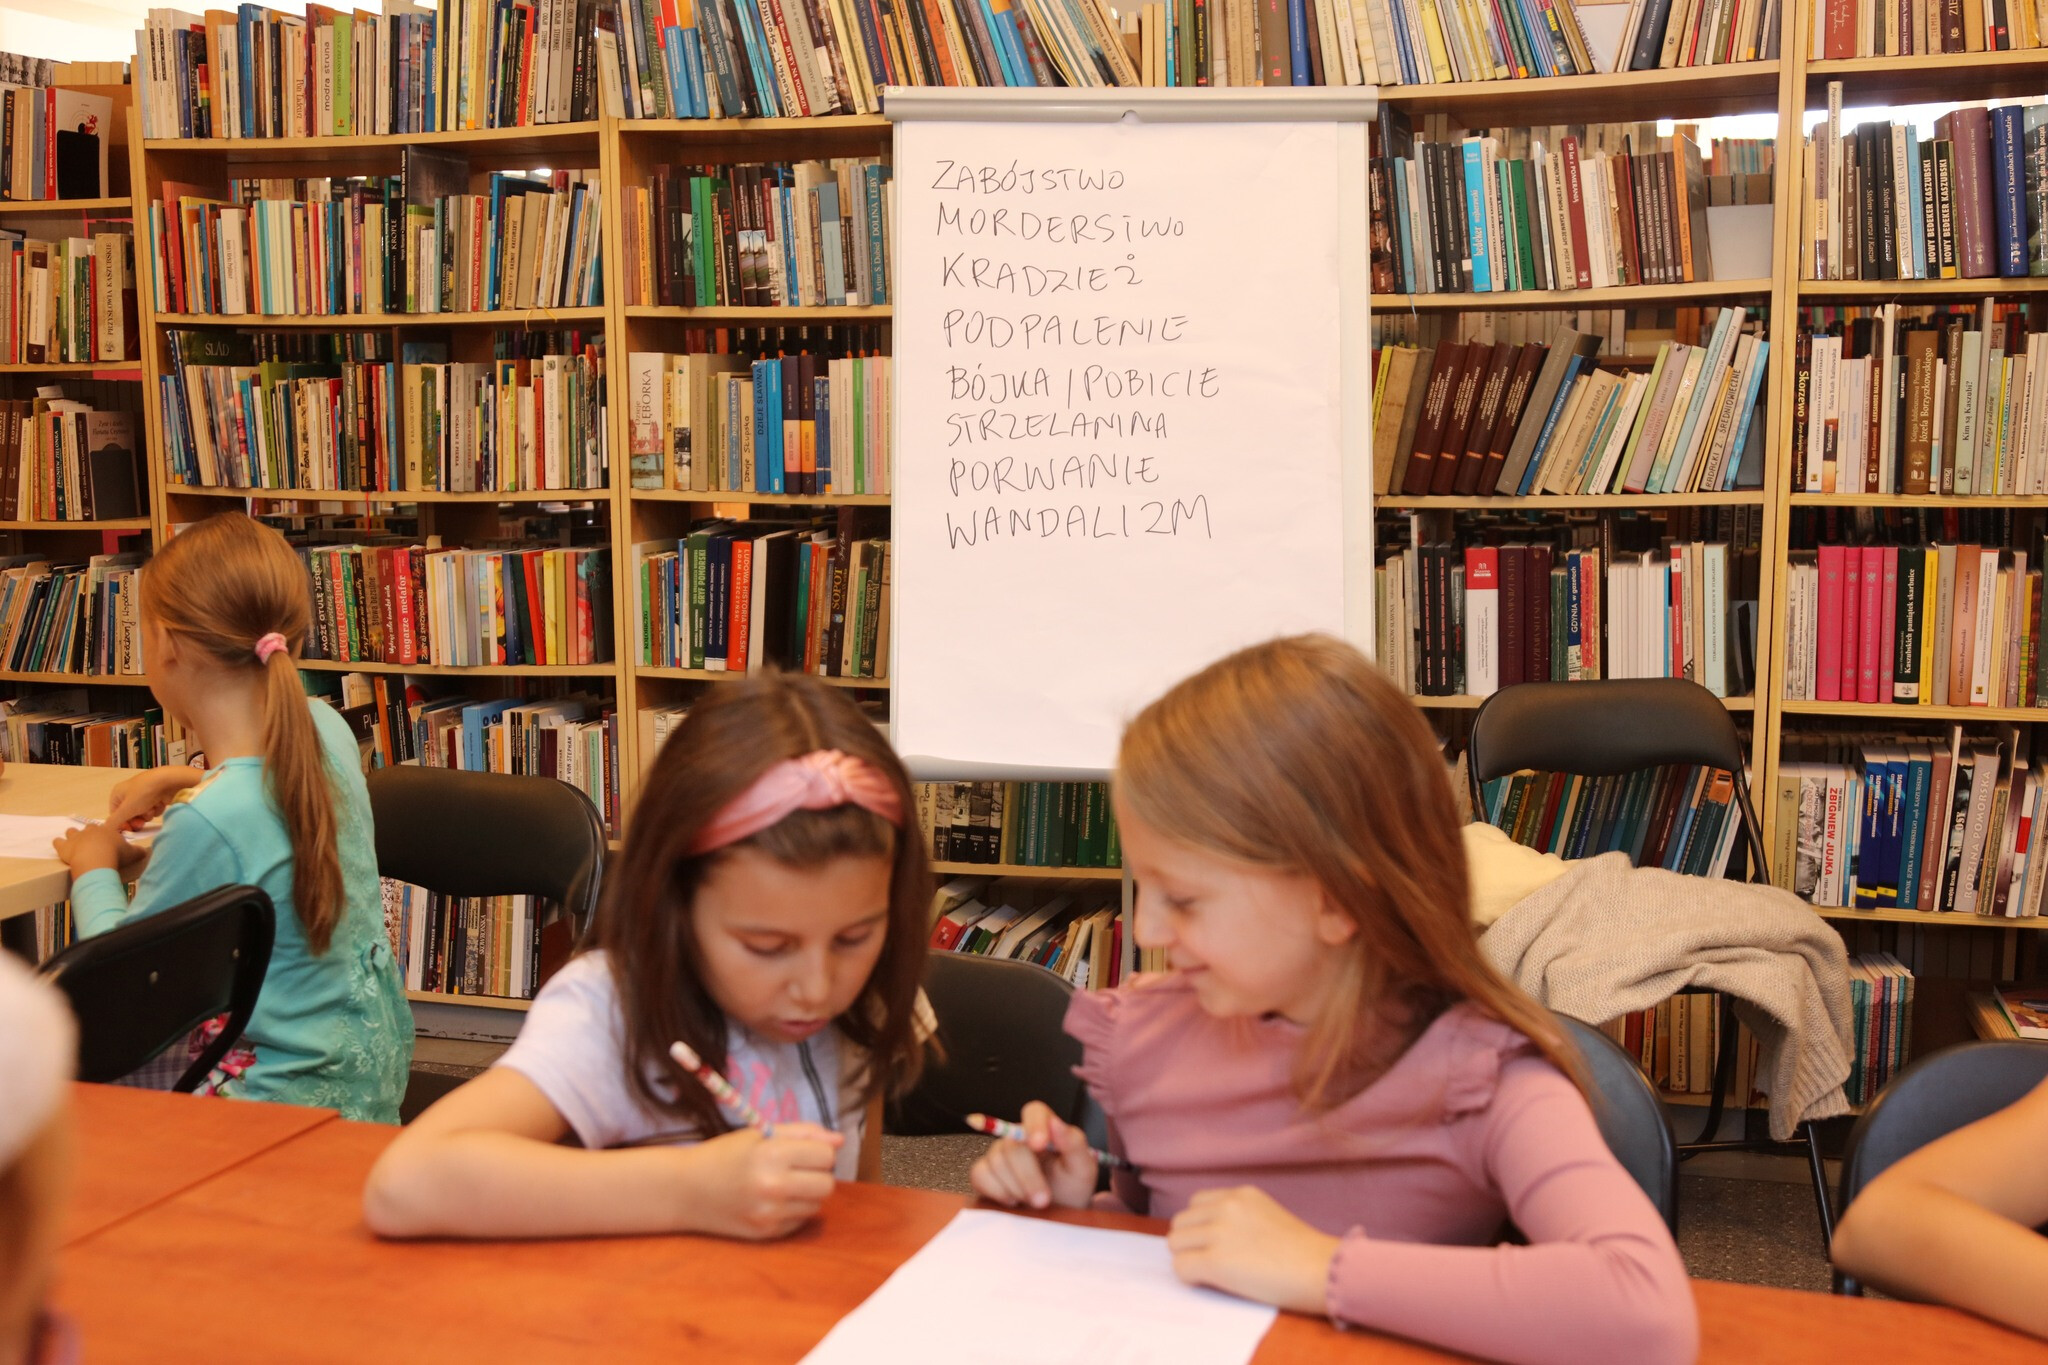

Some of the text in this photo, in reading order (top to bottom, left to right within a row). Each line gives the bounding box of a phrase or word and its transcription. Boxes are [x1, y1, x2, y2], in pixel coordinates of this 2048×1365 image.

[2004, 115, 2013, 145] Kanadzie
[932, 158, 1125, 194] ZABÓJSTWO
[2006, 152, 2014, 186] Kaszubach
[871, 202, 880, 236] DOLINA
[936, 201, 1185, 244] MORDERSTWO
[1922, 159, 1937, 263] NOWY BEDEKER KASZUBSKI
[1939, 159, 1952, 263] NOWY BEDEKER KASZUBSKI
[1472, 225, 1485, 257] bedeker
[942, 253, 1144, 297] KRADZIEŻ
[106, 289, 114, 336] PRZYSŁOWIA
[942, 308, 1190, 350] PODPALENIE
[641, 369, 653, 426] LĘBORKA
[754, 366, 765, 437] DZIEJE SŁAWNA
[945, 363, 1051, 405] BÓJKA
[1083, 364, 1220, 399] POBICIE
[1585, 384, 1608, 422] POMORZE
[1796, 370, 1810, 418] Skorzewo
[1920, 346, 1934, 443] Józefa Borzyszkowskiego
[1963, 380, 1974, 414] Kaszubi?
[946, 411, 1168, 448] STRZELANINA
[1704, 369, 1742, 489] RADACKI ŚREDNIOWIECZNE
[1961, 425, 1970, 441] Kim
[949, 454, 1160, 498] PORWANIE
[945, 493, 1213, 550] WANDALIZM
[697, 548, 707, 605] GRYF POMORSKI
[733, 548, 743, 623] ADAM LESZCZYŃSKI
[831, 566, 843, 611] SOPOT
[1570, 566, 1580, 594] gazetach
[398, 574, 413, 659] tragarze metafor
[738, 548, 751, 654] LUDOWA HISTORIA POLSKI
[1570, 602, 1579, 634] GDYNIA
[1904, 568, 1918, 674] Kaszubskich pamiątek skarbnice
[320, 624, 330, 652] MOŻE
[565, 735, 573, 762] STEPHAN
[1913, 766, 1924, 808] KASZUBSKIEGO
[1824, 787, 1838, 876] ZBIGNIEW JUJKA
[1907, 820, 1918, 859] POMORSKIEGO
[1963, 770, 1992, 899] RODZINA POMORSKA
[1903, 879, 1913, 904] SŁOWNIK
